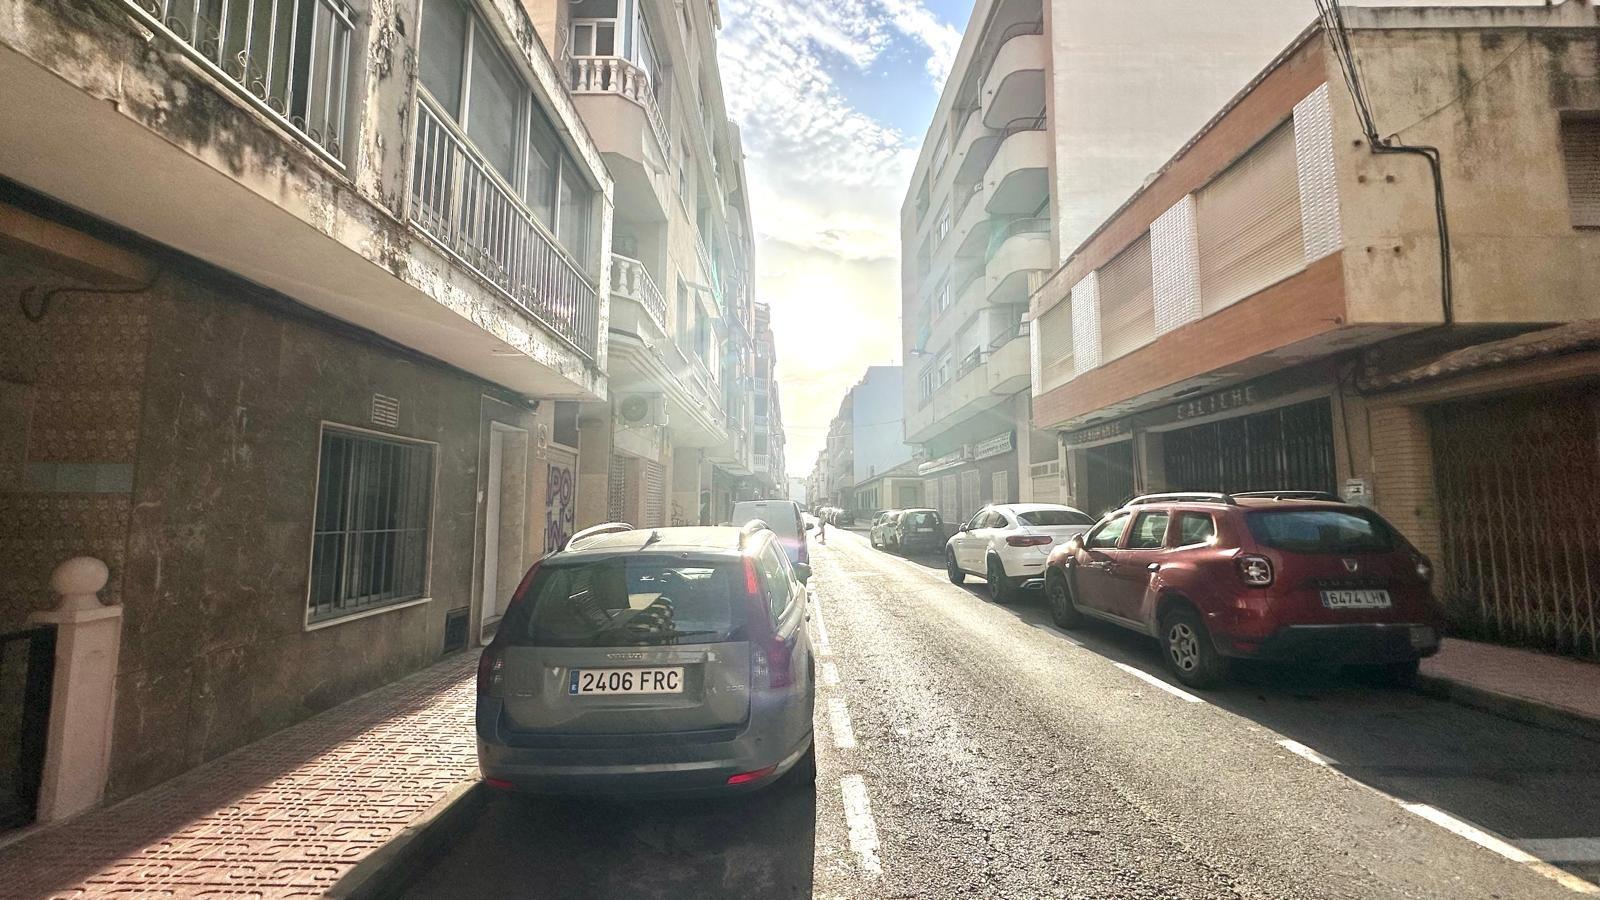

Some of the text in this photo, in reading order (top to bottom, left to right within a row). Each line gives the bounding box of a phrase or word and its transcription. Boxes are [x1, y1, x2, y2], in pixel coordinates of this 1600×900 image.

[1330, 592, 1363, 605] 6474
[582, 672, 633, 692] 2406
[640, 670, 678, 690] FRC
